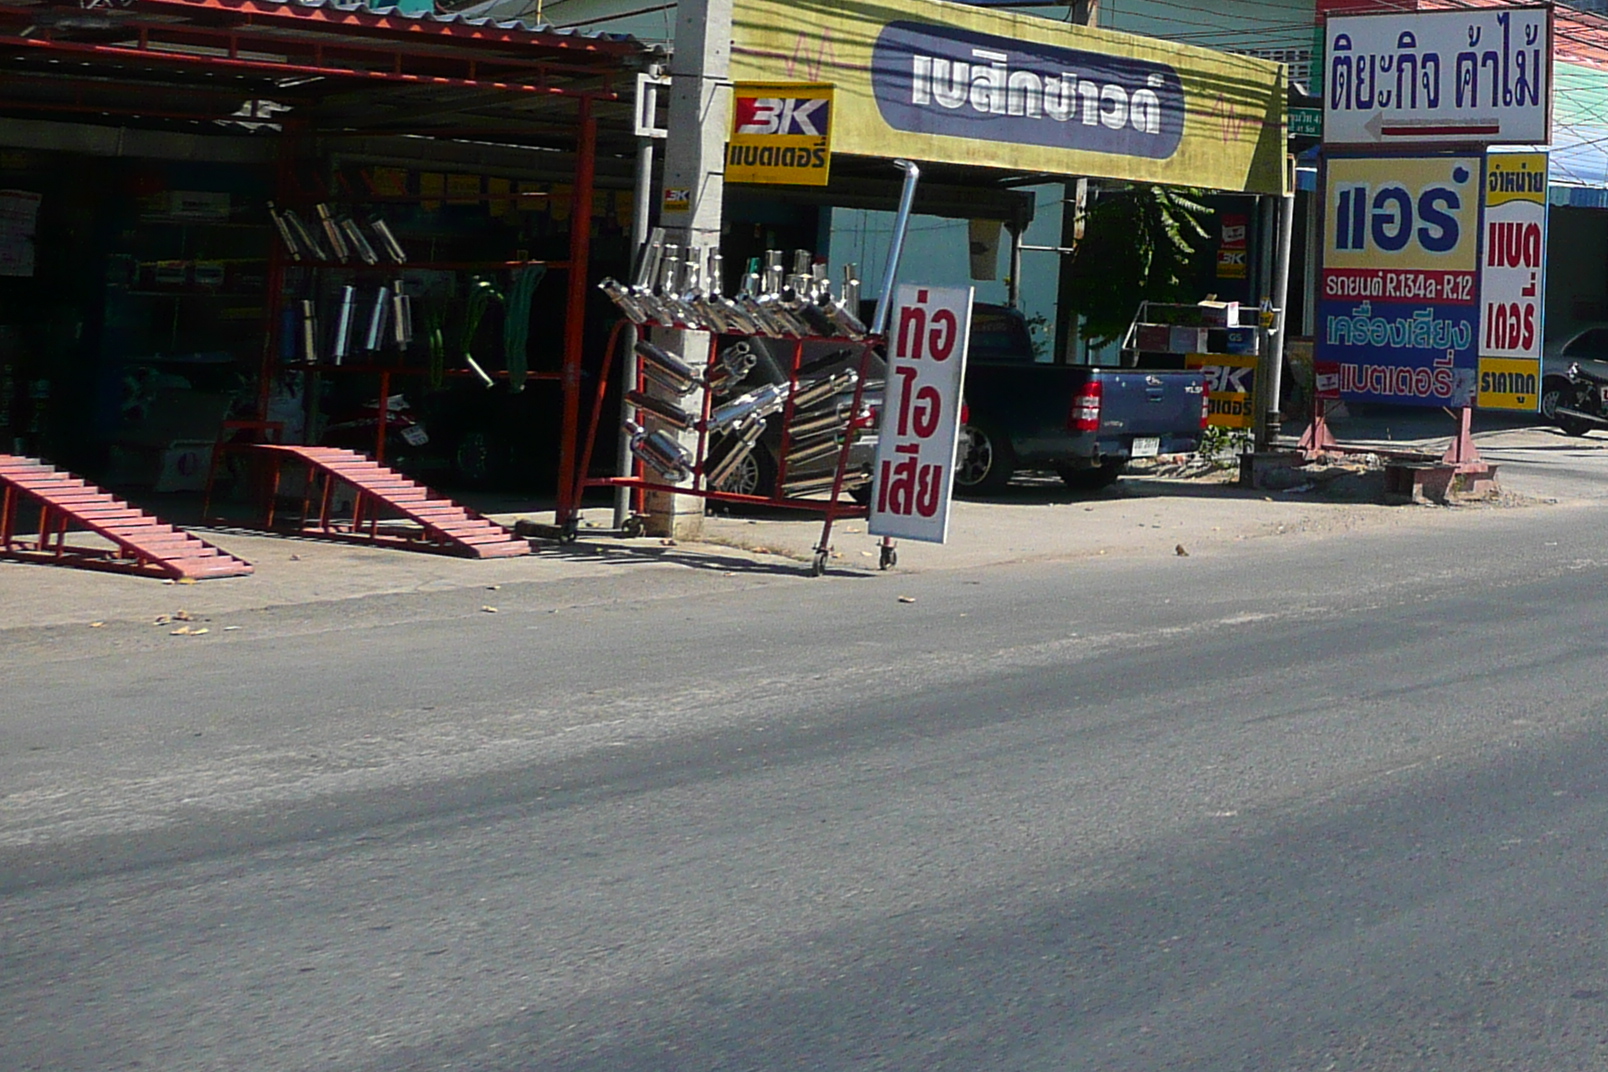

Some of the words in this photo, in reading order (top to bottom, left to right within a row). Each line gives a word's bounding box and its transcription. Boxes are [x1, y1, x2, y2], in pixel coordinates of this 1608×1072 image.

[1331, 31, 1440, 110] ติยะกิจ
[1456, 11, 1540, 108] ค้าไม้
[738, 98, 829, 136] 3K
[729, 136, 827, 168] แบตเตอรี่
[666, 190, 689, 201] 3K
[1488, 163, 1544, 193] จำหน่าย
[1336, 165, 1470, 253] แอร์
[1219, 253, 1245, 265] 3K
[1488, 222, 1541, 268] แบต
[1326, 271, 1383, 297] รถยนต์
[896, 289, 957, 362] ท่อ
[1327, 300, 1472, 351] เครื่องเสียง
[1486, 271, 1537, 352] เตอรี่
[1228, 333, 1243, 342] GS
[1340, 349, 1455, 398] แบตเตอรี่
[1480, 371, 1536, 404] ราคาถูก
[895, 366, 942, 439] ไอ
[877, 442, 943, 518] เสีย
